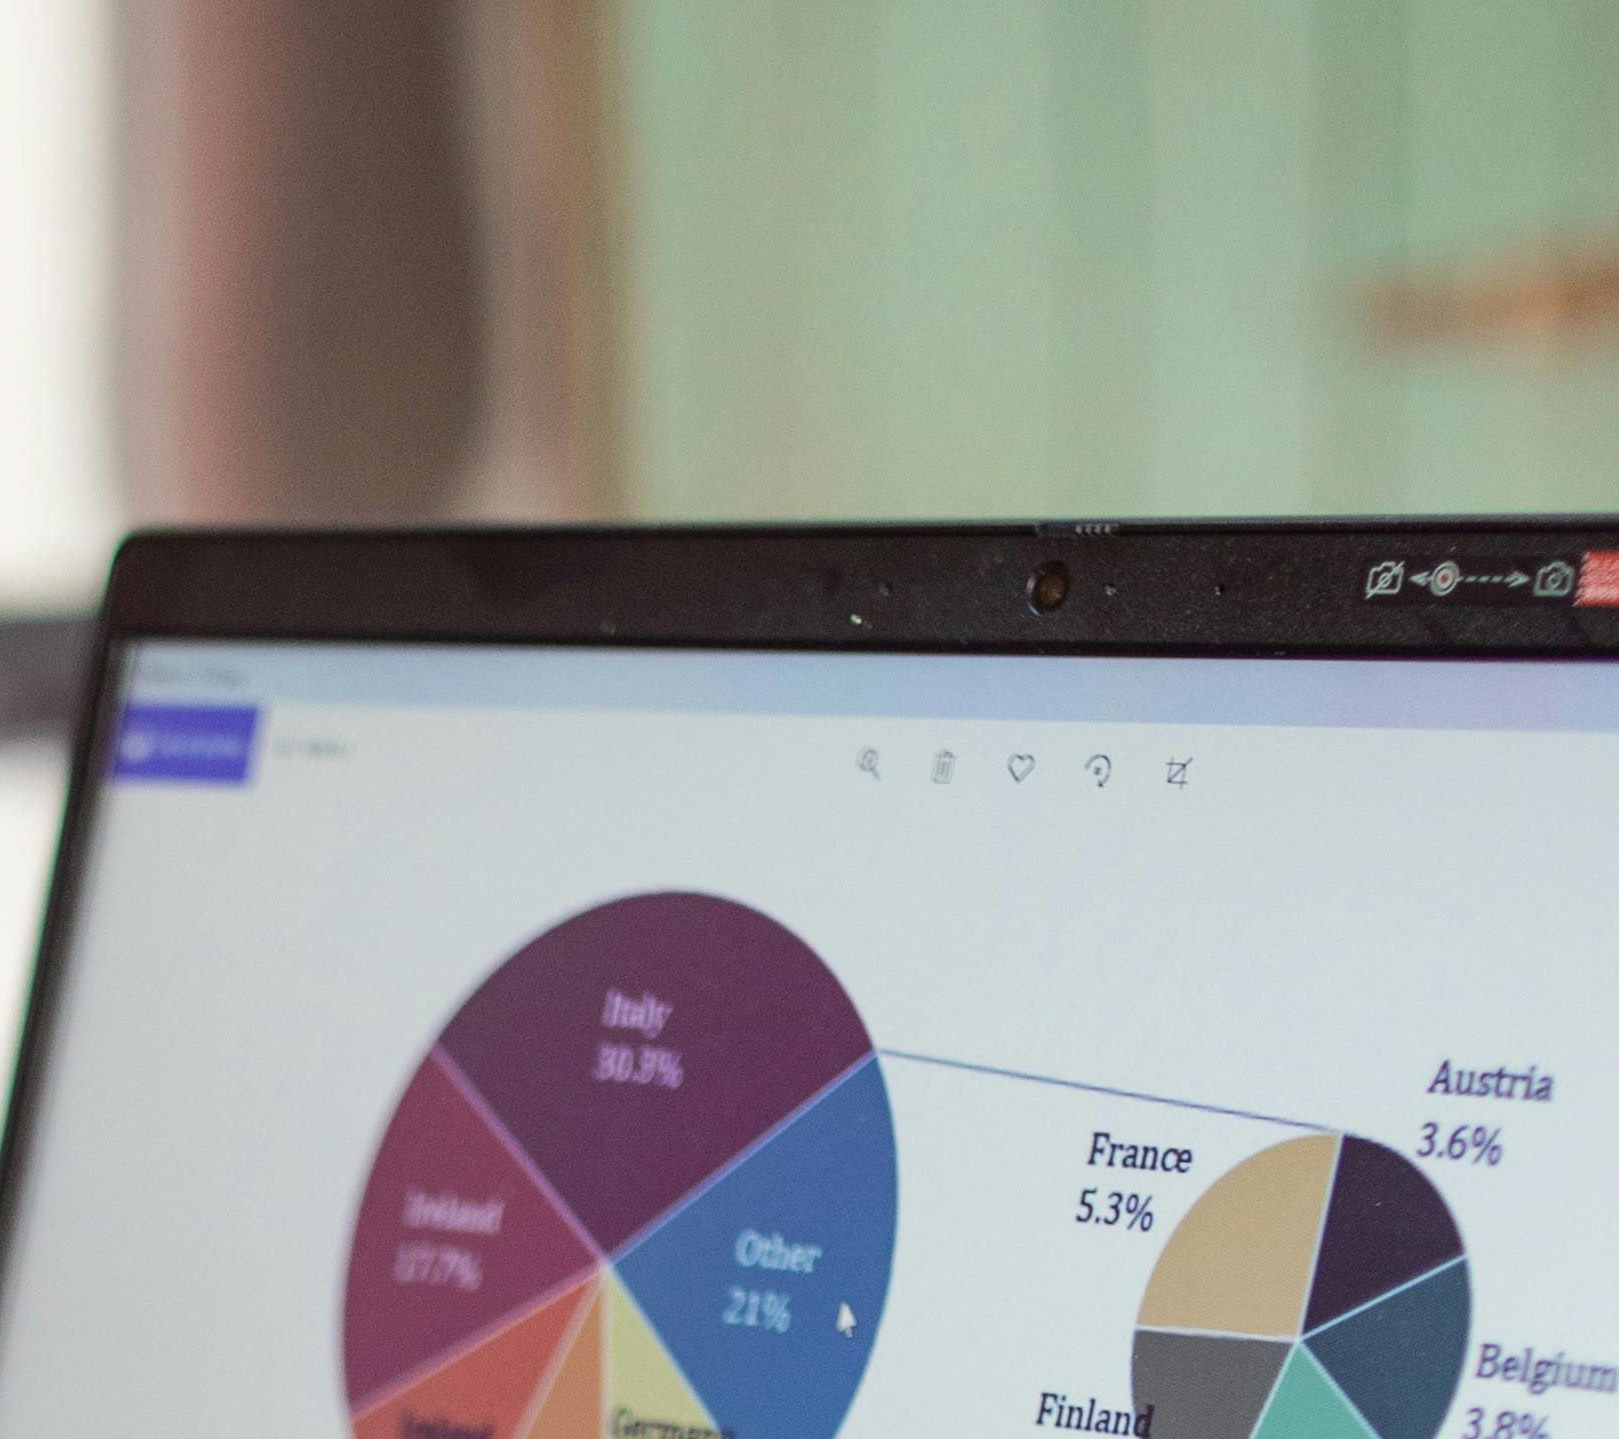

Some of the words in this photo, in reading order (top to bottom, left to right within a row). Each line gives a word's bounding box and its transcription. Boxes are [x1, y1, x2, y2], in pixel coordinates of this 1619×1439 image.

[601, 987, 673, 1039] Italy
[1425, 1061, 1555, 1103] Austria
[1086, 1132, 1193, 1174] France
[1415, 1121, 1504, 1166] 3.6%
[1074, 1188, 1155, 1232] 5.3%
[735, 1229, 822, 1274] Other
[723, 1286, 791, 1333] 21%
[1474, 1343, 1619, 1395] Belgium
[1034, 1392, 1155, 1439] Finland
